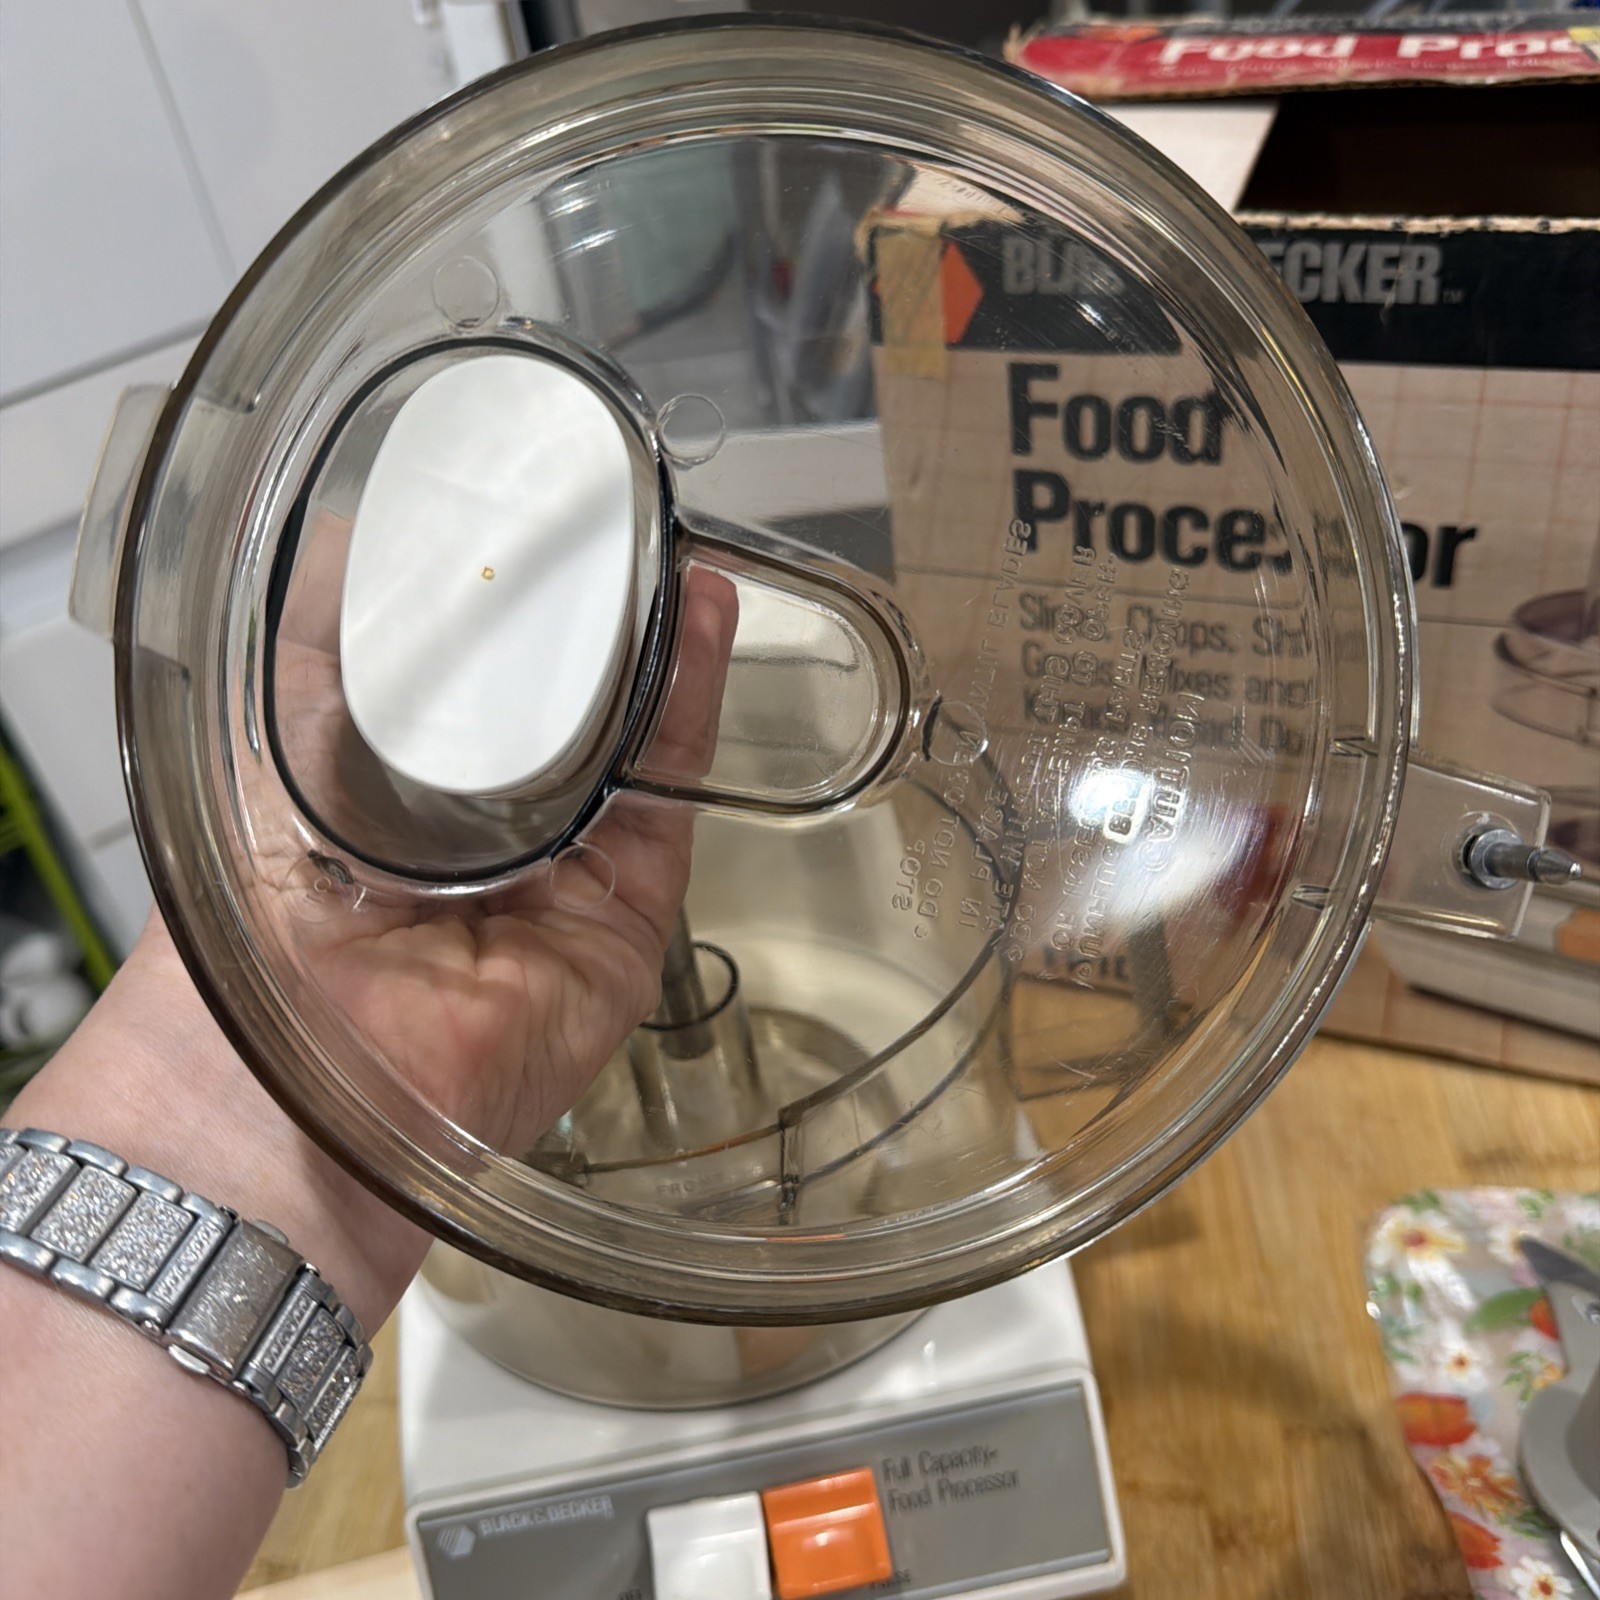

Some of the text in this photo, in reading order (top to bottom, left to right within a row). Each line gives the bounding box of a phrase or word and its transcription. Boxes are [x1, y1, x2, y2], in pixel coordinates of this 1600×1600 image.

[1159, 34, 1355, 64] Food
[1009, 362, 1225, 466] Food
[882, 1456, 911, 1483] Full
[888, 1469, 1019, 1514] Food Processor
